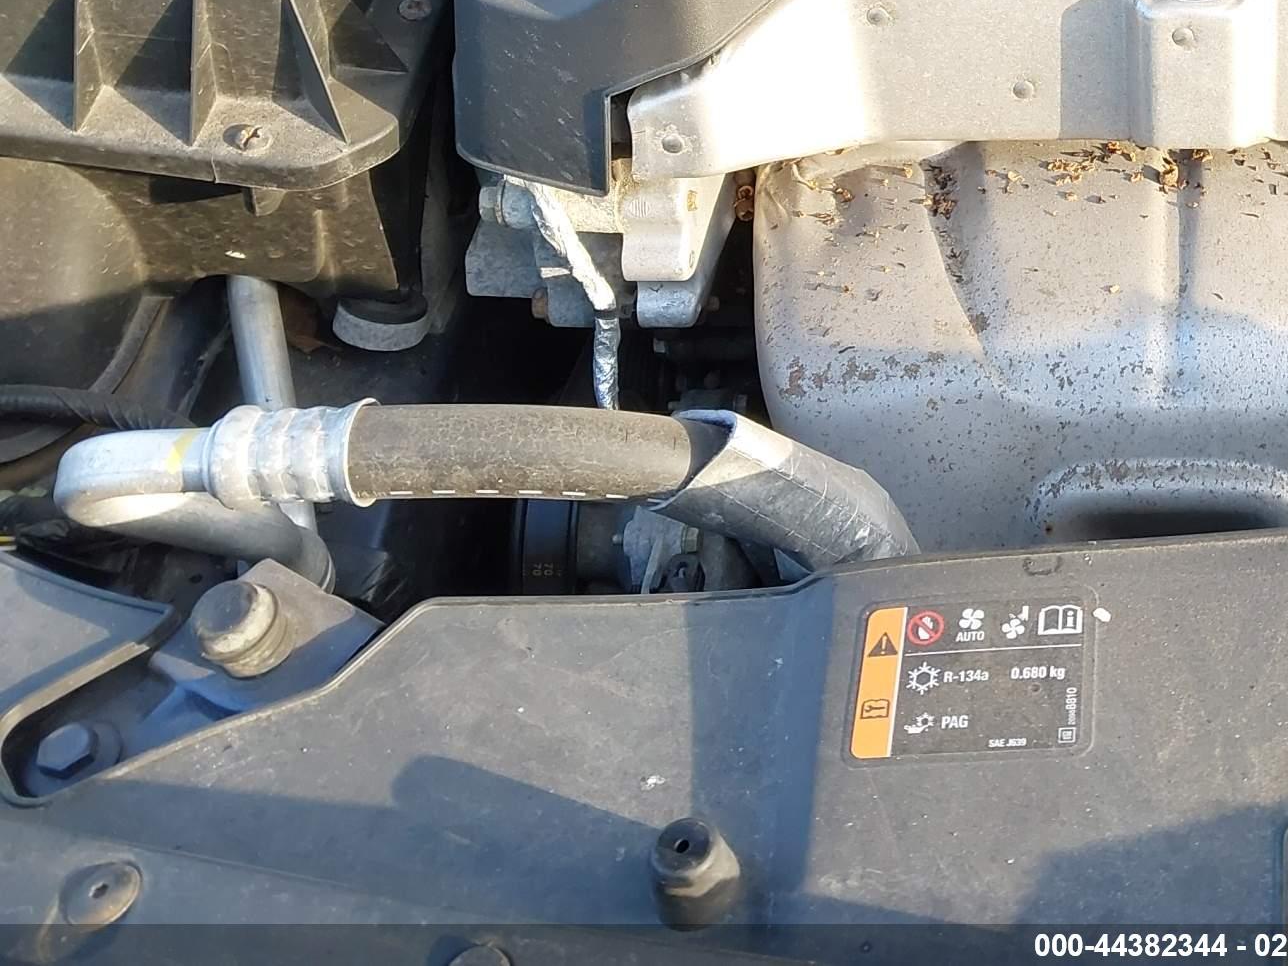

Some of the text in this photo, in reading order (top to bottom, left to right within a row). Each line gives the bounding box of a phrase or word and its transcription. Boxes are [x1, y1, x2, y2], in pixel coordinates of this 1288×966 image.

[956, 631, 985, 642] AUTO
[943, 669, 989, 683] R-134a
[1011, 665, 1066, 681] 0.680 kg
[941, 715, 969, 729] PAG
[988, 738, 1006, 748] SAE
